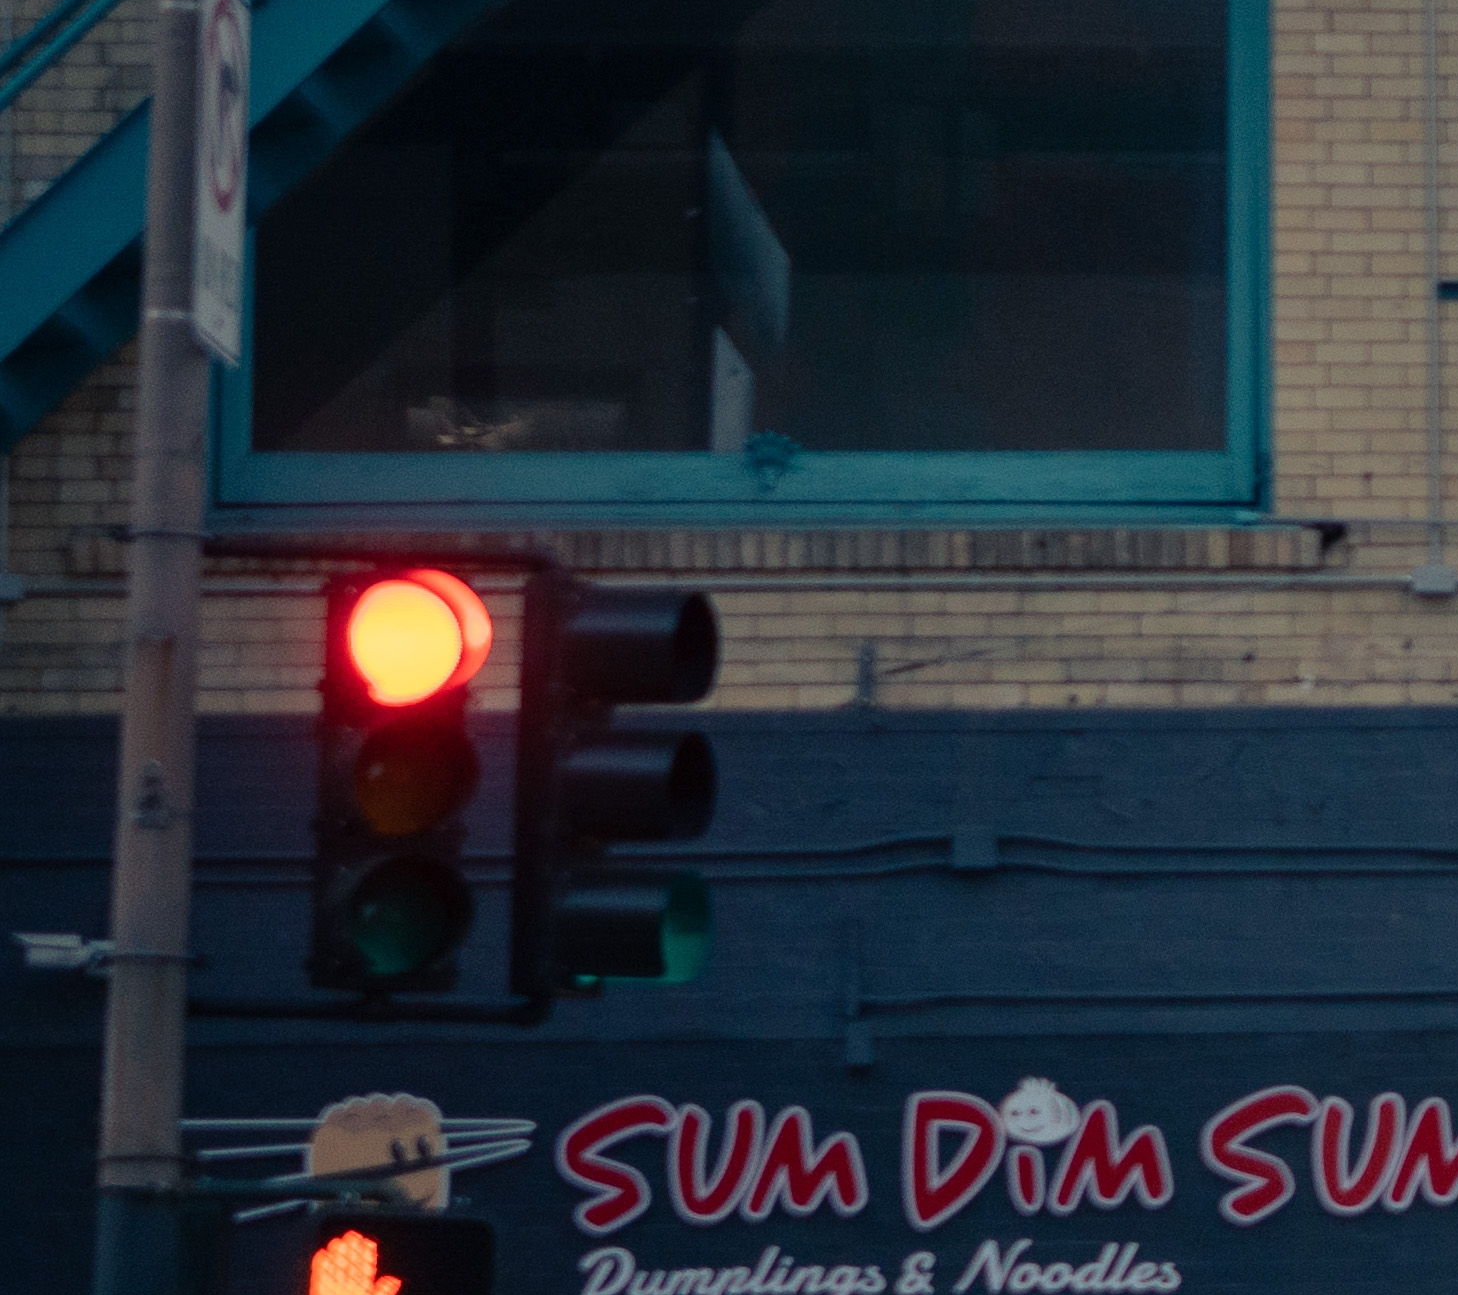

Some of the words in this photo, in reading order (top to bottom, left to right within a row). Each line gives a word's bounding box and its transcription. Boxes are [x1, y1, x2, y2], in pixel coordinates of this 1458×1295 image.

[555, 1094, 869, 1236] SUM
[897, 1249, 937, 1295] &
[951, 1237, 1182, 1295] Noodles
